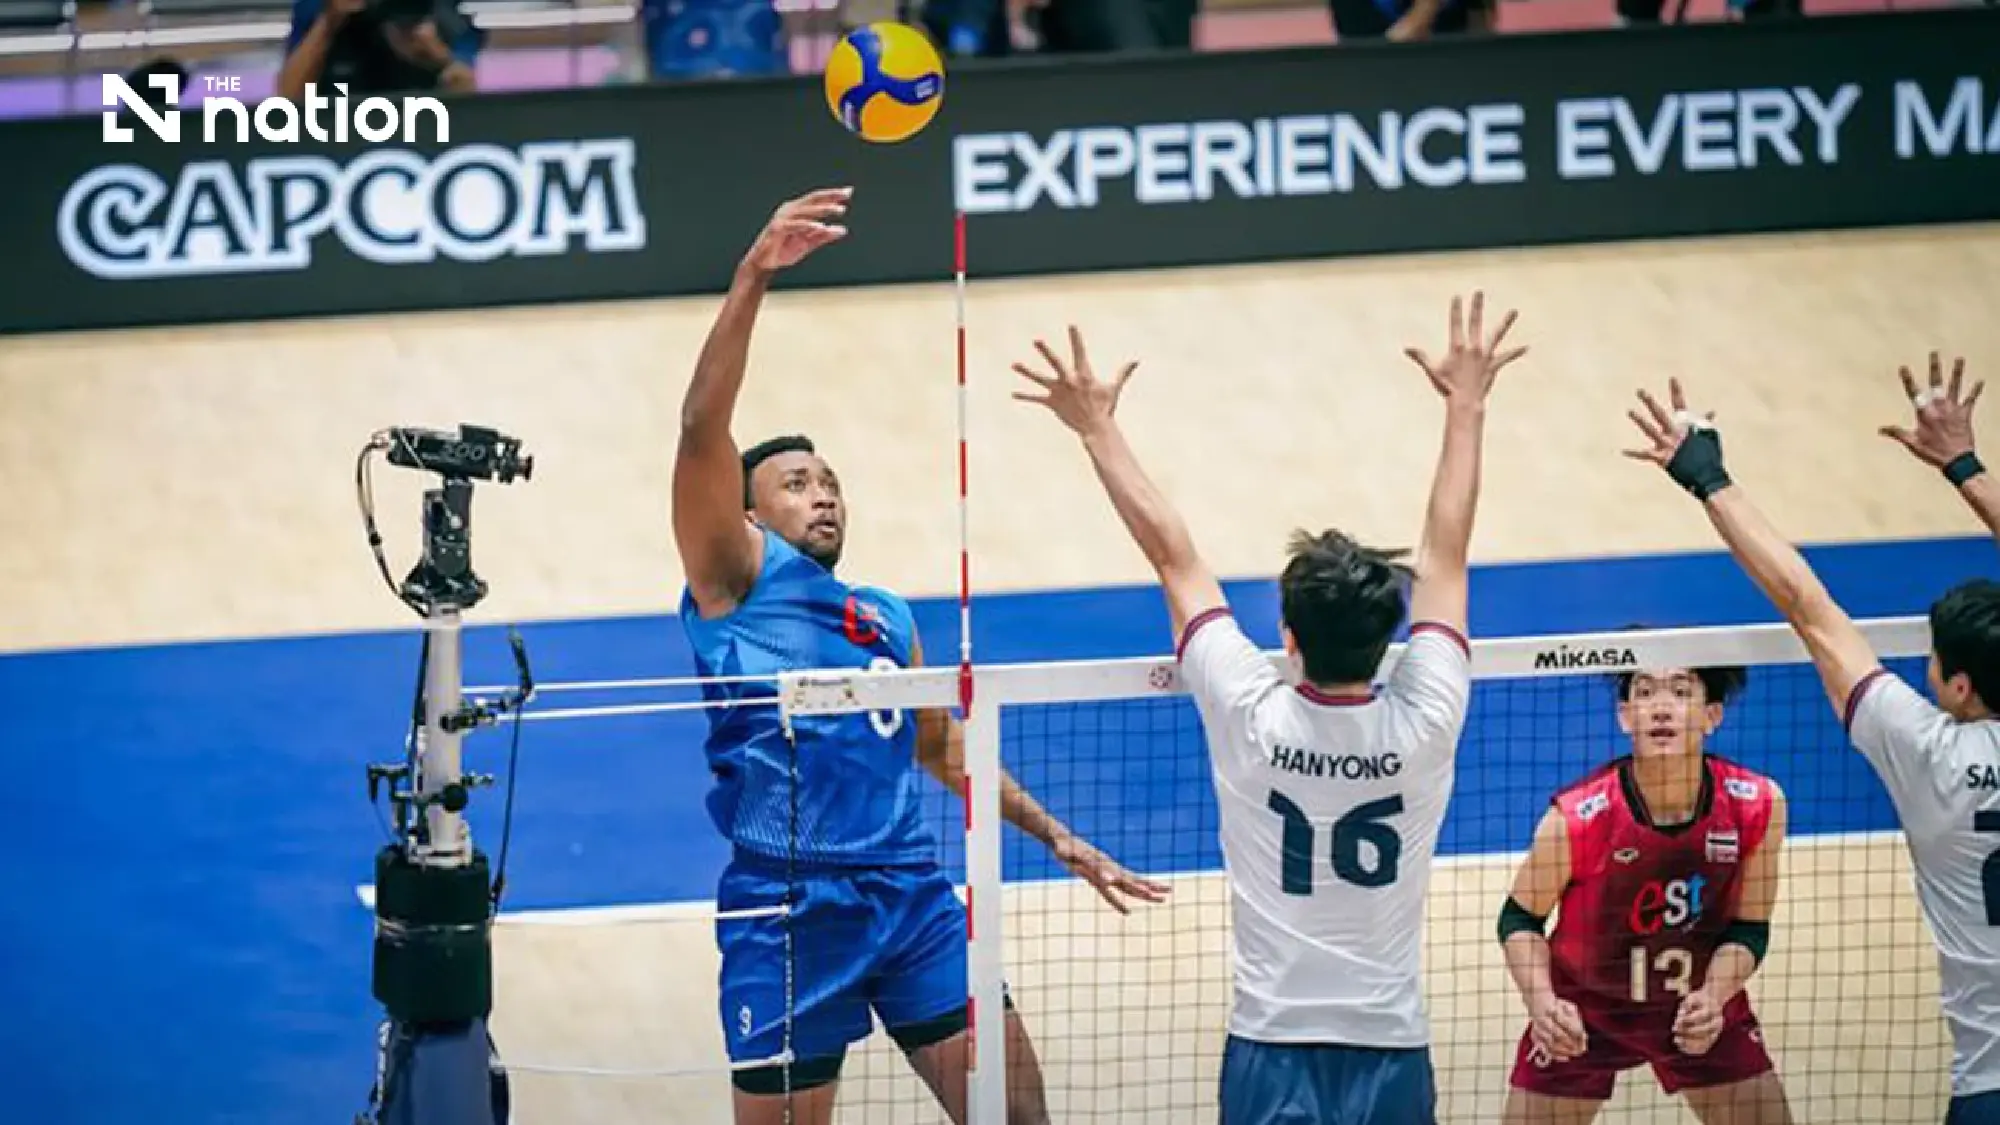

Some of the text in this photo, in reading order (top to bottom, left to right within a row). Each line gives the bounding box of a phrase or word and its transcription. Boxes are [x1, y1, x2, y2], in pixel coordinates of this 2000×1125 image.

[953, 75, 2000, 213] EXPERIENCE EVERY M
[57, 138, 646, 280] CAPCOM
[1270, 744, 1404, 780] HANYONG
[1966, 763, 2000, 789] SA
[1267, 788, 1404, 897] 16
[1629, 872, 1707, 935] est
[1629, 945, 1693, 1004] 13
